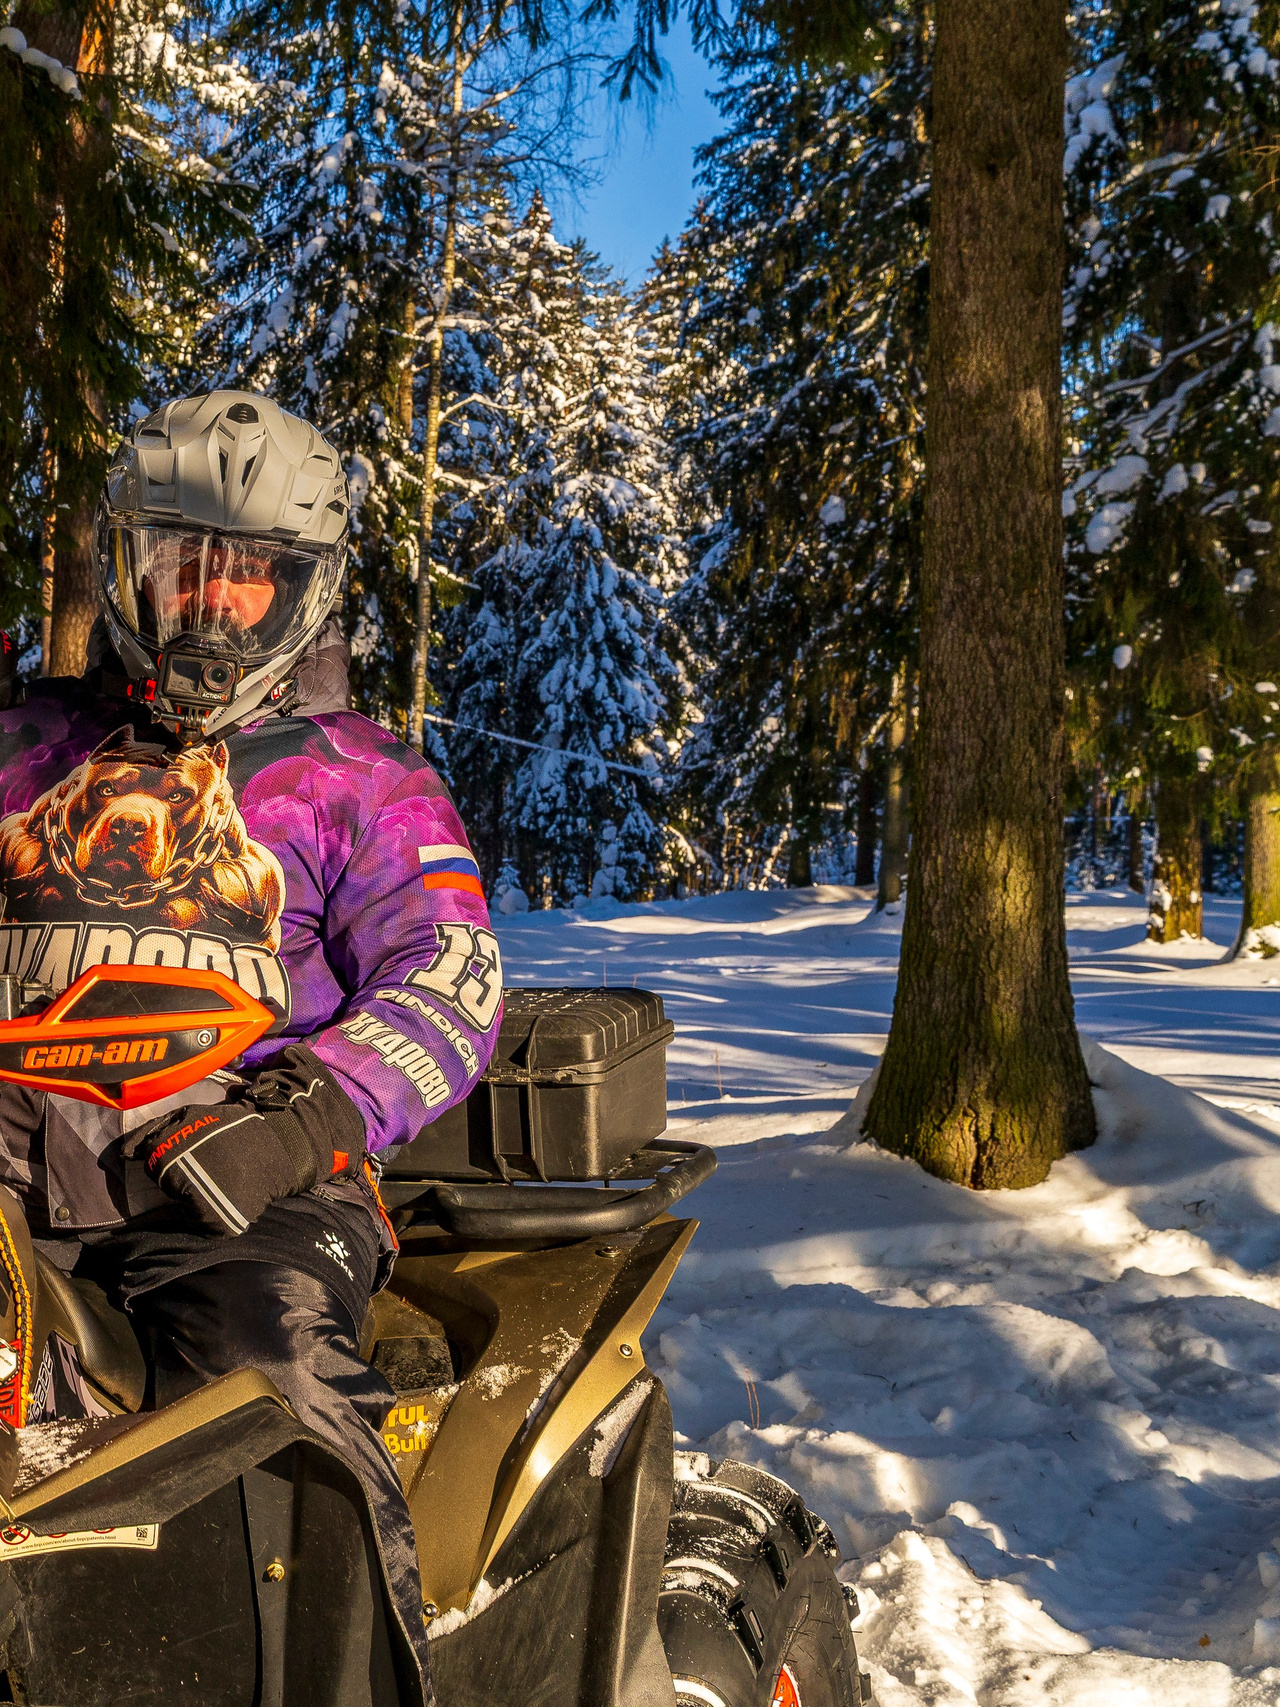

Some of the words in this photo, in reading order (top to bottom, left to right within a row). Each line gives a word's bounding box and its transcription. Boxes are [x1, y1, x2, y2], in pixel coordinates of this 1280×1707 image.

[402, 922, 503, 1033] 13
[23, 1037, 169, 1069] can-am
[148, 1114, 220, 1171] FINNTRAIL
[315, 1240, 355, 1282] KELME
